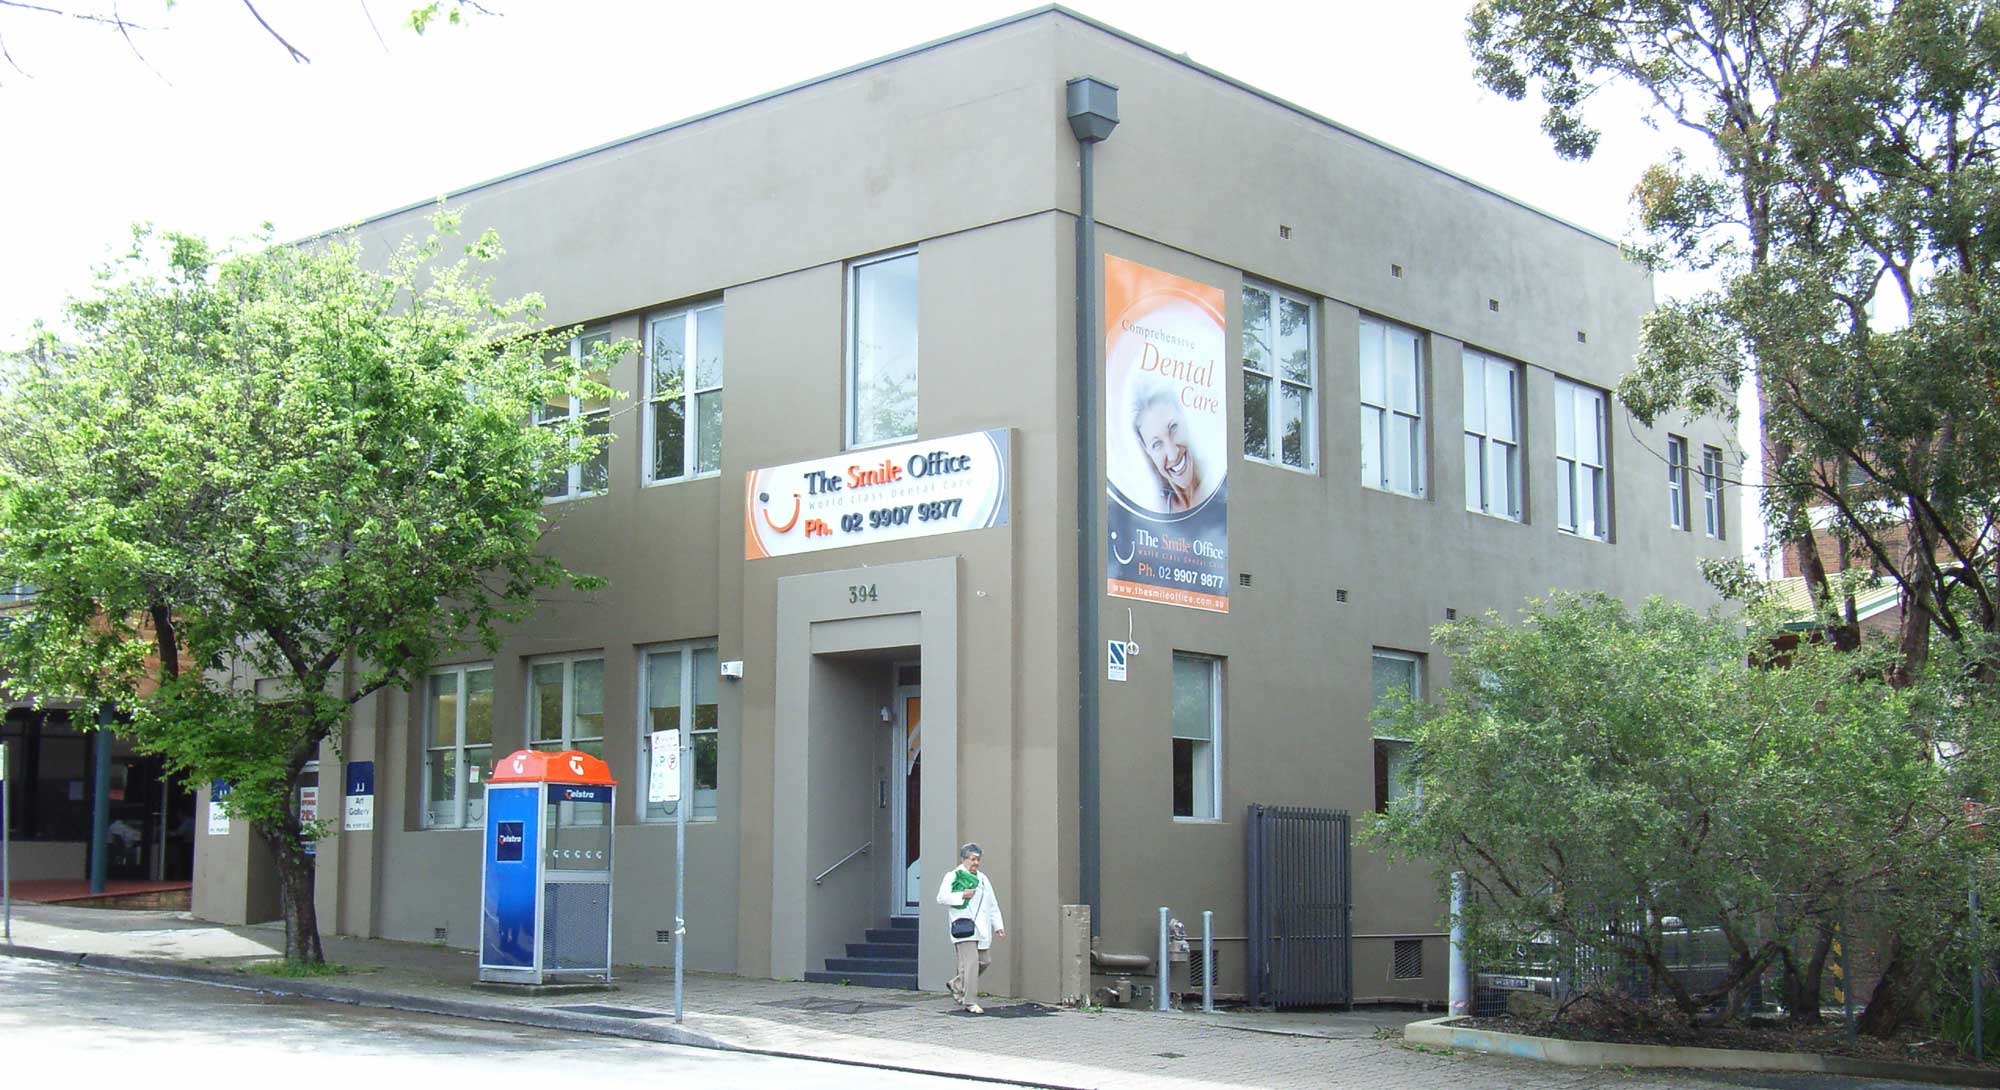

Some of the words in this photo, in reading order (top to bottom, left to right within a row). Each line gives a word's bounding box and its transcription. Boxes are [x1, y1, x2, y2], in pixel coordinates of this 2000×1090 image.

[1122, 320, 1195, 349] Comprehensive
[1140, 342, 1214, 387] Dental
[1181, 386, 1218, 414] Care
[804, 470, 842, 496] The
[846, 459, 902, 489] Smile
[907, 451, 971, 479] Office
[809, 496, 843, 510] World
[891, 481, 936, 498] Dental
[943, 479, 973, 490] Care
[805, 518, 833, 538] Ph.
[841, 512, 863, 533] 02
[869, 505, 913, 529] 9907
[918, 498, 963, 522] 9877
[1136, 529, 1159, 548] The
[1162, 534, 1191, 553] Smile
[1193, 540, 1224, 559] Office
[1138, 563, 1155, 577] Ph.
[1158, 566, 1171, 580] 02
[1174, 568, 1197, 584] 9907
[1201, 573, 1224, 589] 9877
[849, 584, 878, 604] 394
[1113, 584, 1224, 608] www.thesmileoffice.com.au
[565, 789, 595, 800] Telstra
[499, 835, 522, 845] Telstra
